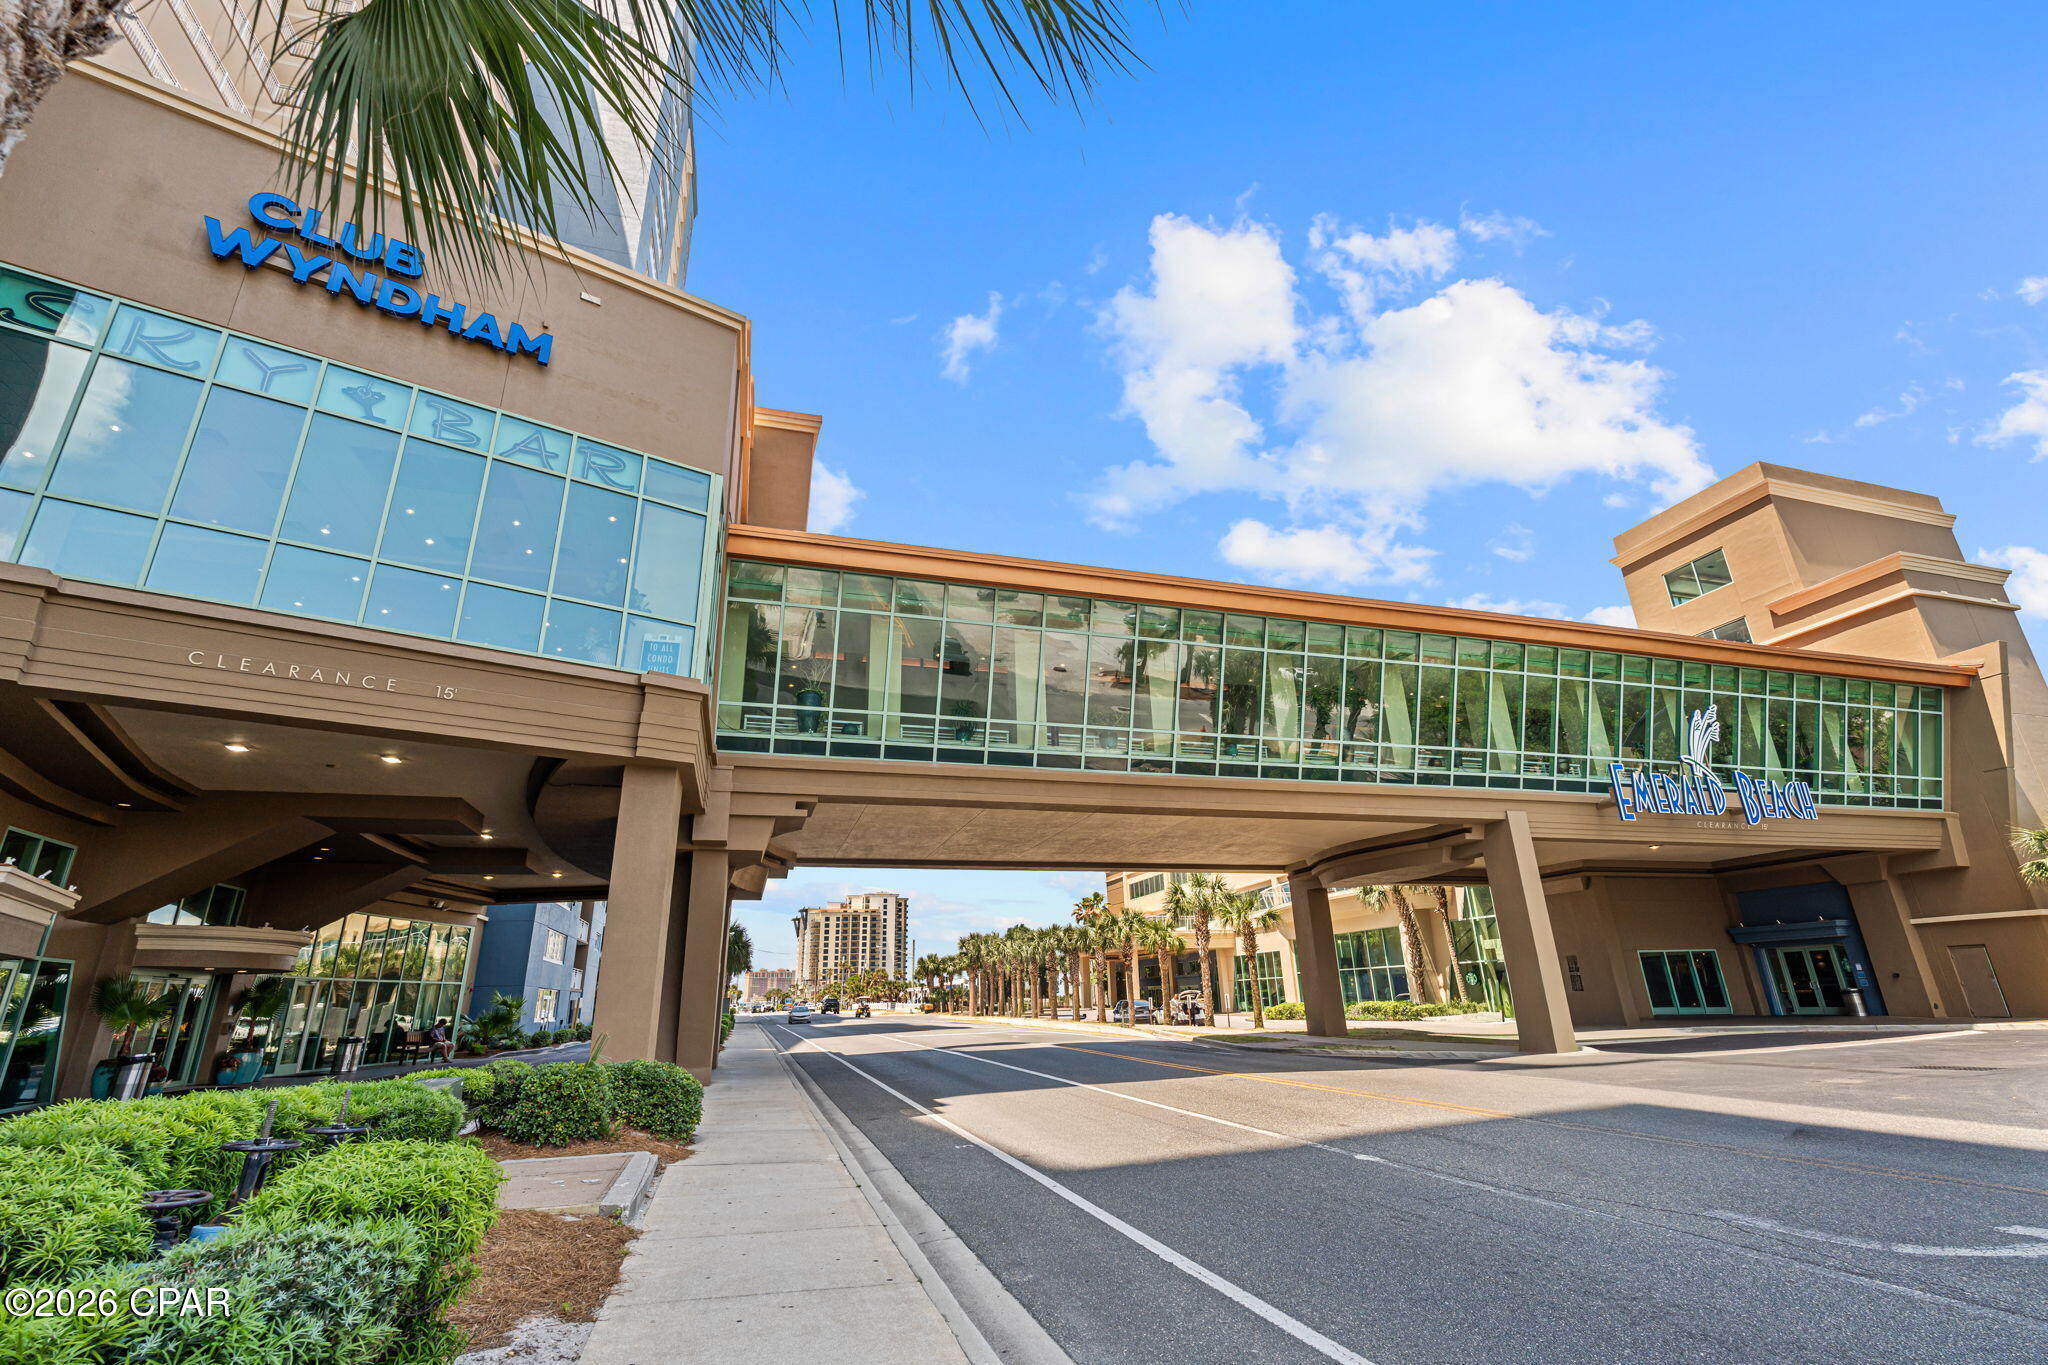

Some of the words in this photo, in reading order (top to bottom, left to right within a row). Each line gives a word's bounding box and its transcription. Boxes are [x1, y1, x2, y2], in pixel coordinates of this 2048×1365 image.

[248, 191, 427, 280] CLUB
[203, 215, 555, 368] WYNDHAM
[426, 400, 636, 492] BAR
[187, 650, 397, 692] CLEARANCE
[434, 684, 459, 700] 15'
[647, 654, 673, 664] CONDO
[1608, 762, 1727, 822] EMERALD
[1731, 770, 1819, 826] BEACH
